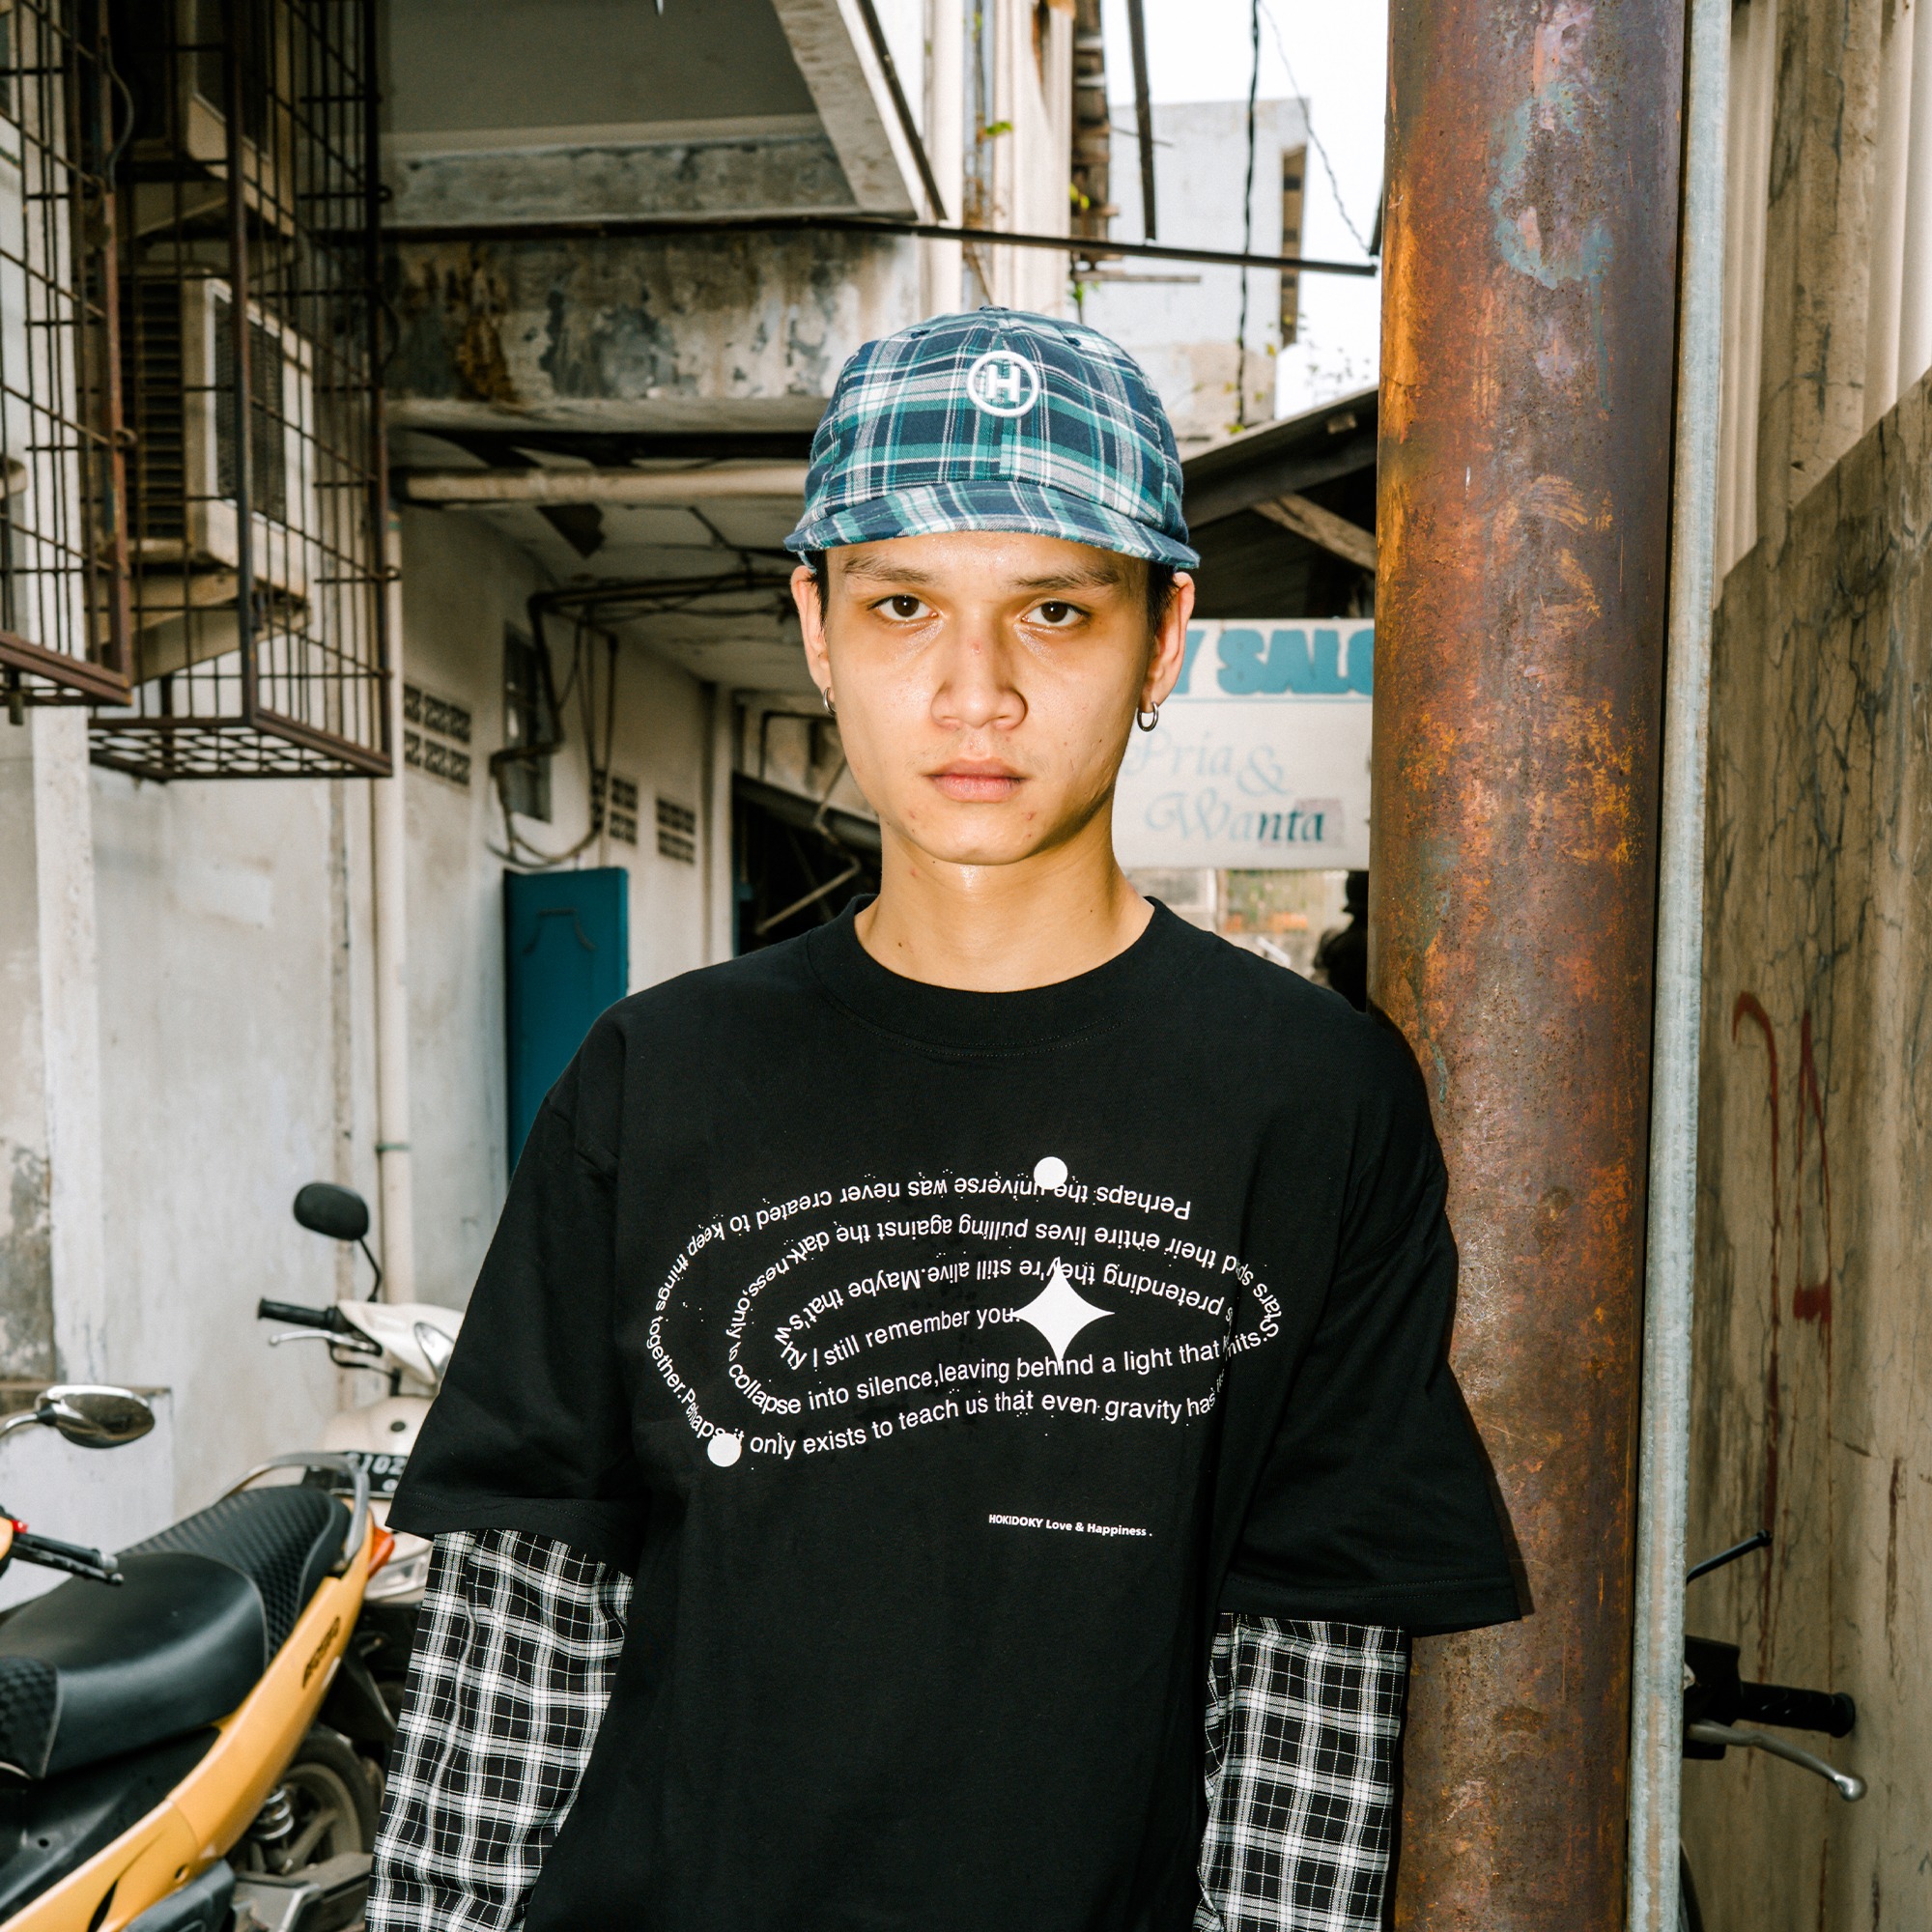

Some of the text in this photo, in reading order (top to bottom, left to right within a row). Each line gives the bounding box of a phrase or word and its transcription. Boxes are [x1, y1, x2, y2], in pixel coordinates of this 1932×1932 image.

[839, 1182, 900, 1204] never
[907, 1179, 948, 1197] was
[1053, 1182, 1089, 1204] the
[755, 1190, 833, 1231] created
[1095, 1184, 1191, 1221] Perhaps
[729, 1214, 752, 1233] to
[836, 1224, 871, 1244] the
[876, 1213, 953, 1241] against
[958, 1213, 1029, 1241] pulling
[1035, 1223, 1087, 1247] lives
[686, 1221, 725, 1257] keep
[1094, 1227, 1161, 1251] entire
[1164, 1237, 1217, 1269] their
[655, 1253, 689, 1312] things
[976, 1259, 1012, 1281] still
[1102, 1263, 1225, 1316] pretending
[788, 1288, 844, 1330] that's
[865, 1310, 971, 1349] remember
[728, 1341, 742, 1362] to
[774, 1326, 808, 1371] why
[812, 1348, 818, 1368] I
[823, 1334, 861, 1366] still
[1179, 1340, 1220, 1365] that
[1016, 1353, 1094, 1378] behind
[1101, 1356, 1117, 1374] a
[1123, 1348, 1174, 1376] light
[728, 1363, 802, 1415] collapse
[809, 1386, 849, 1410] into
[994, 1390, 1035, 1412] that
[897, 1399, 959, 1431] teach
[965, 1397, 989, 1415] us
[1040, 1394, 1097, 1415] even
[1104, 1400, 1182, 1425] gravity
[1186, 1392, 1216, 1417] has
[803, 1428, 867, 1455] exists
[870, 1420, 894, 1439] to
[750, 1432, 797, 1461] only
[988, 1514, 1043, 1528] HOKIDOKY
[1045, 1519, 1073, 1531] Love
[1074, 1521, 1085, 1532] &
[1087, 1522, 1147, 1537] Happiness
